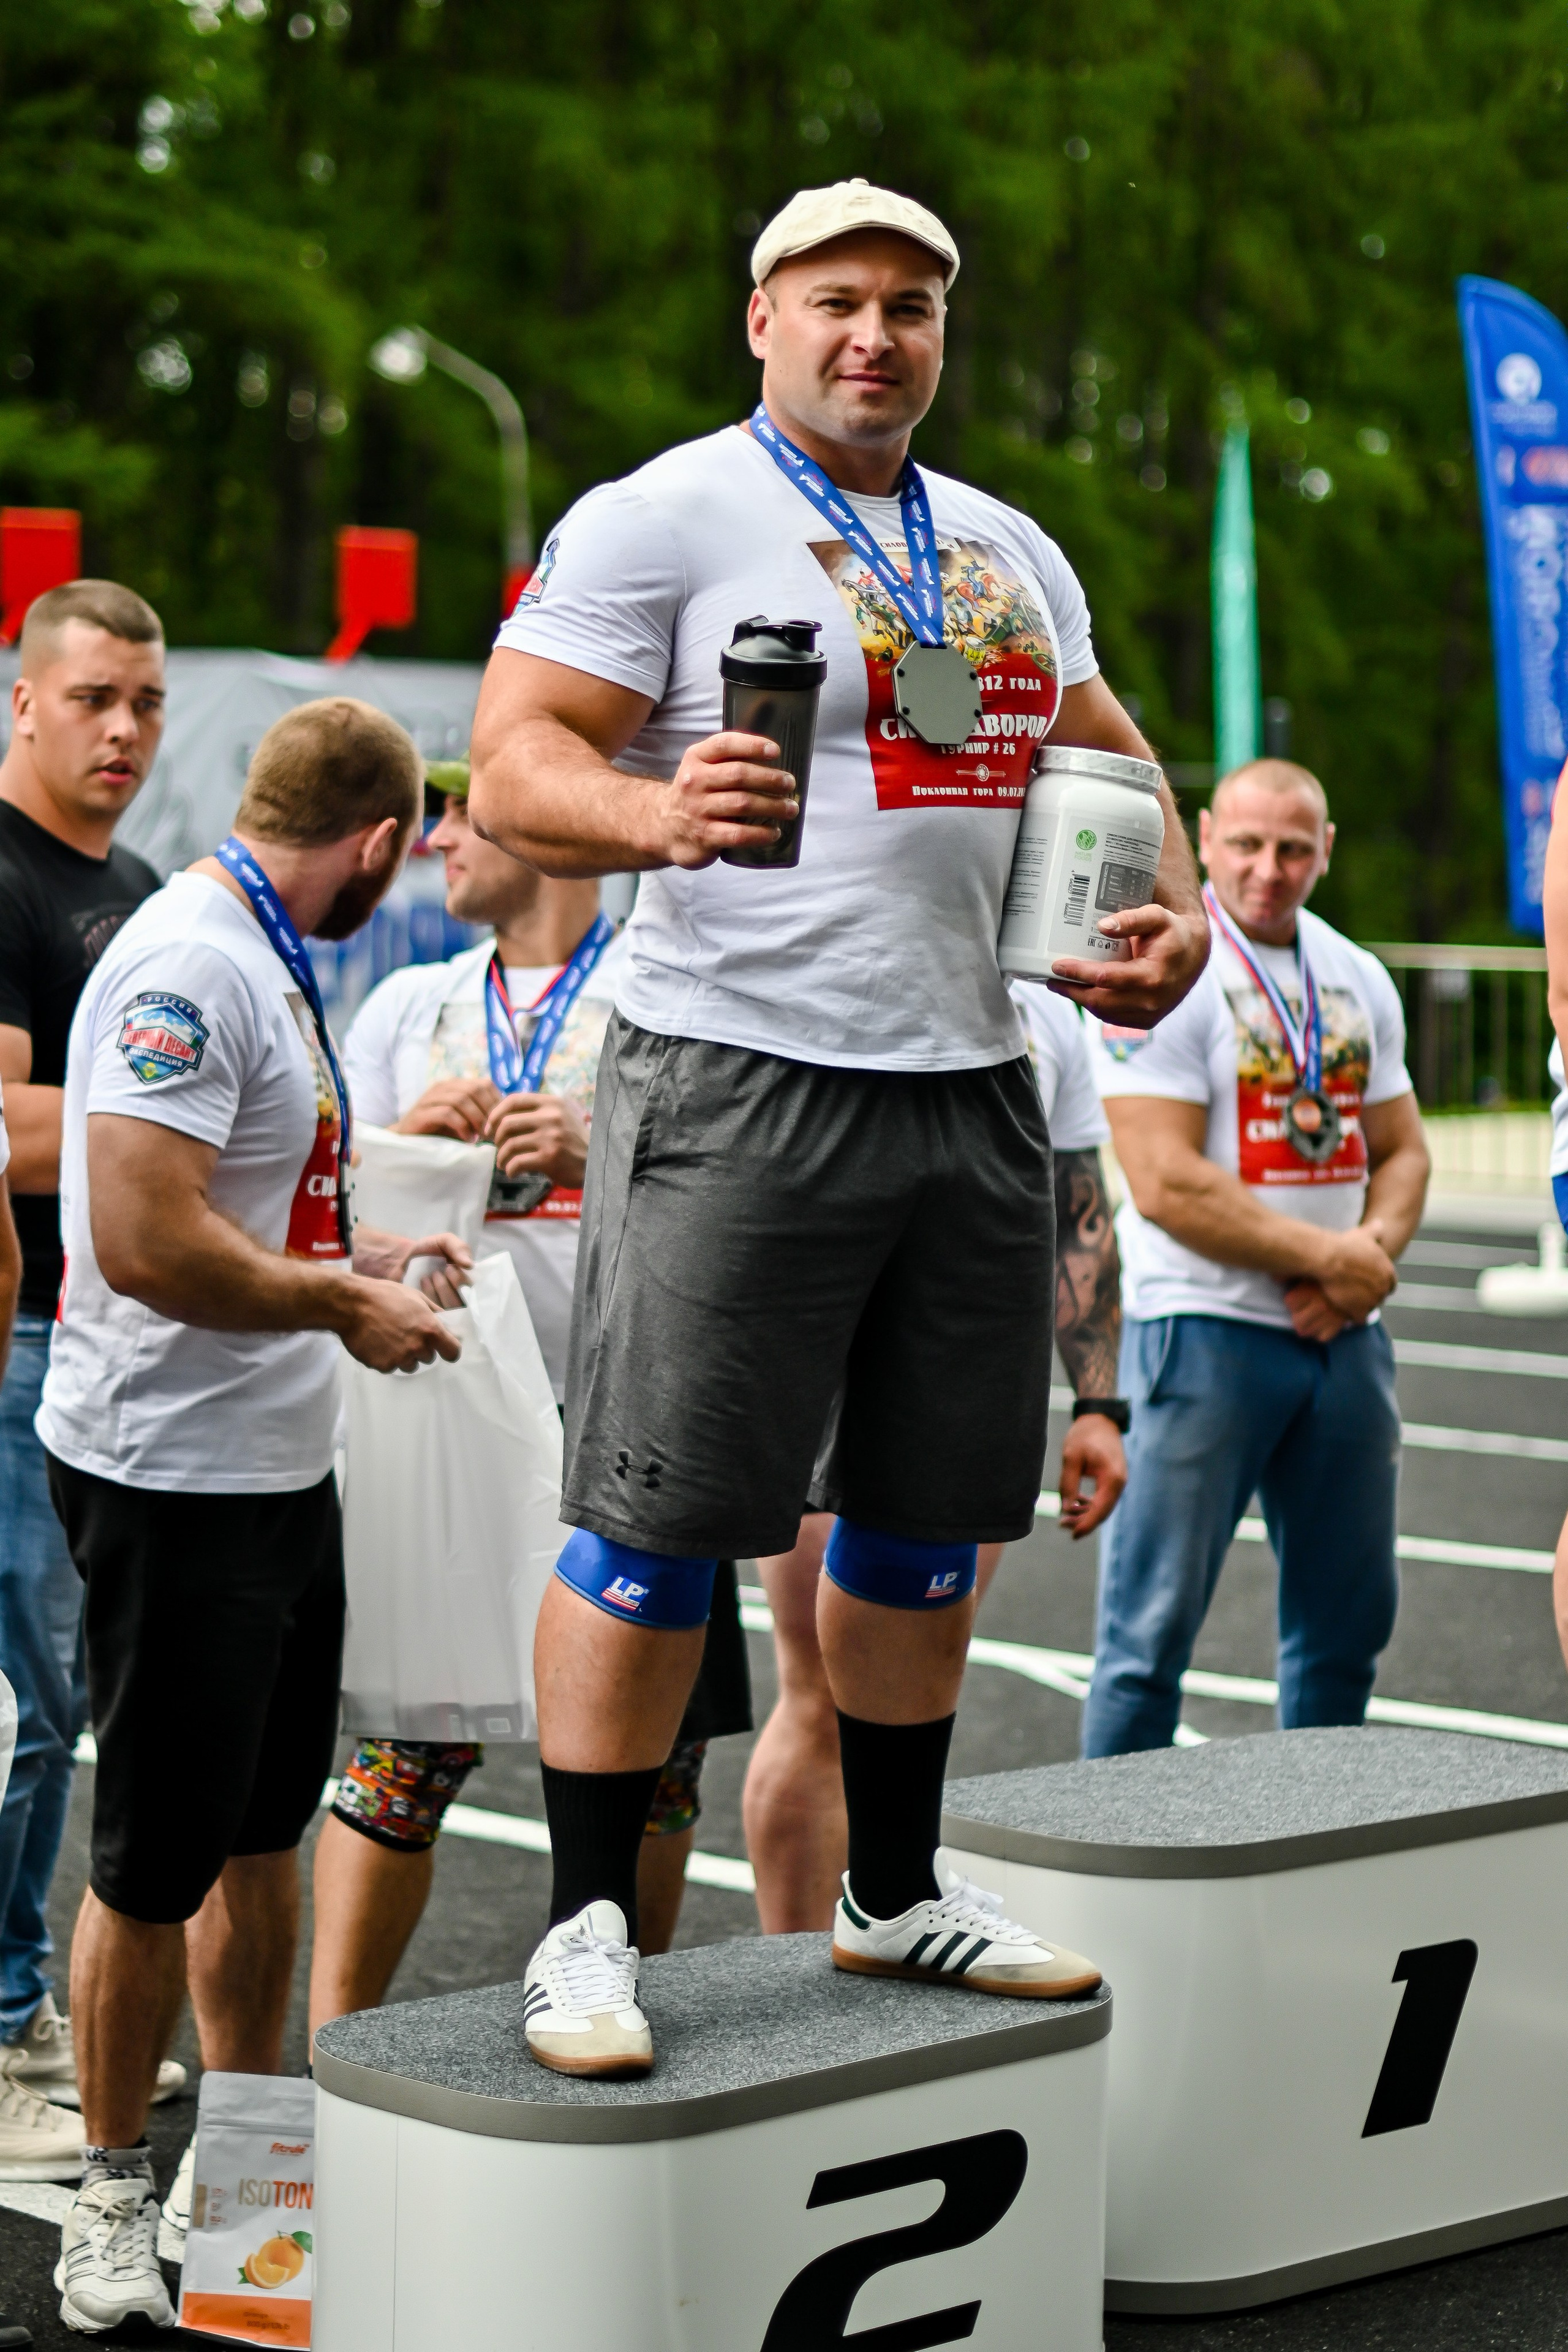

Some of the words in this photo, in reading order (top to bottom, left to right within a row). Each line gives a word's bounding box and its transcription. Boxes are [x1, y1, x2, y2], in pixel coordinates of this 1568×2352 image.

[978, 675, 1003, 691] 812
[880, 718, 917, 741] СИ
[1003, 743, 1016, 755] 26
[998, 786, 1026, 797] 09.07.202
[147, 996, 192, 1014] РОССИЯ
[129, 1047, 183, 1067] ЭКСПЕДИЦИЯ
[1361, 1939, 1478, 2138] 1
[760, 2128, 1028, 2352] 2
